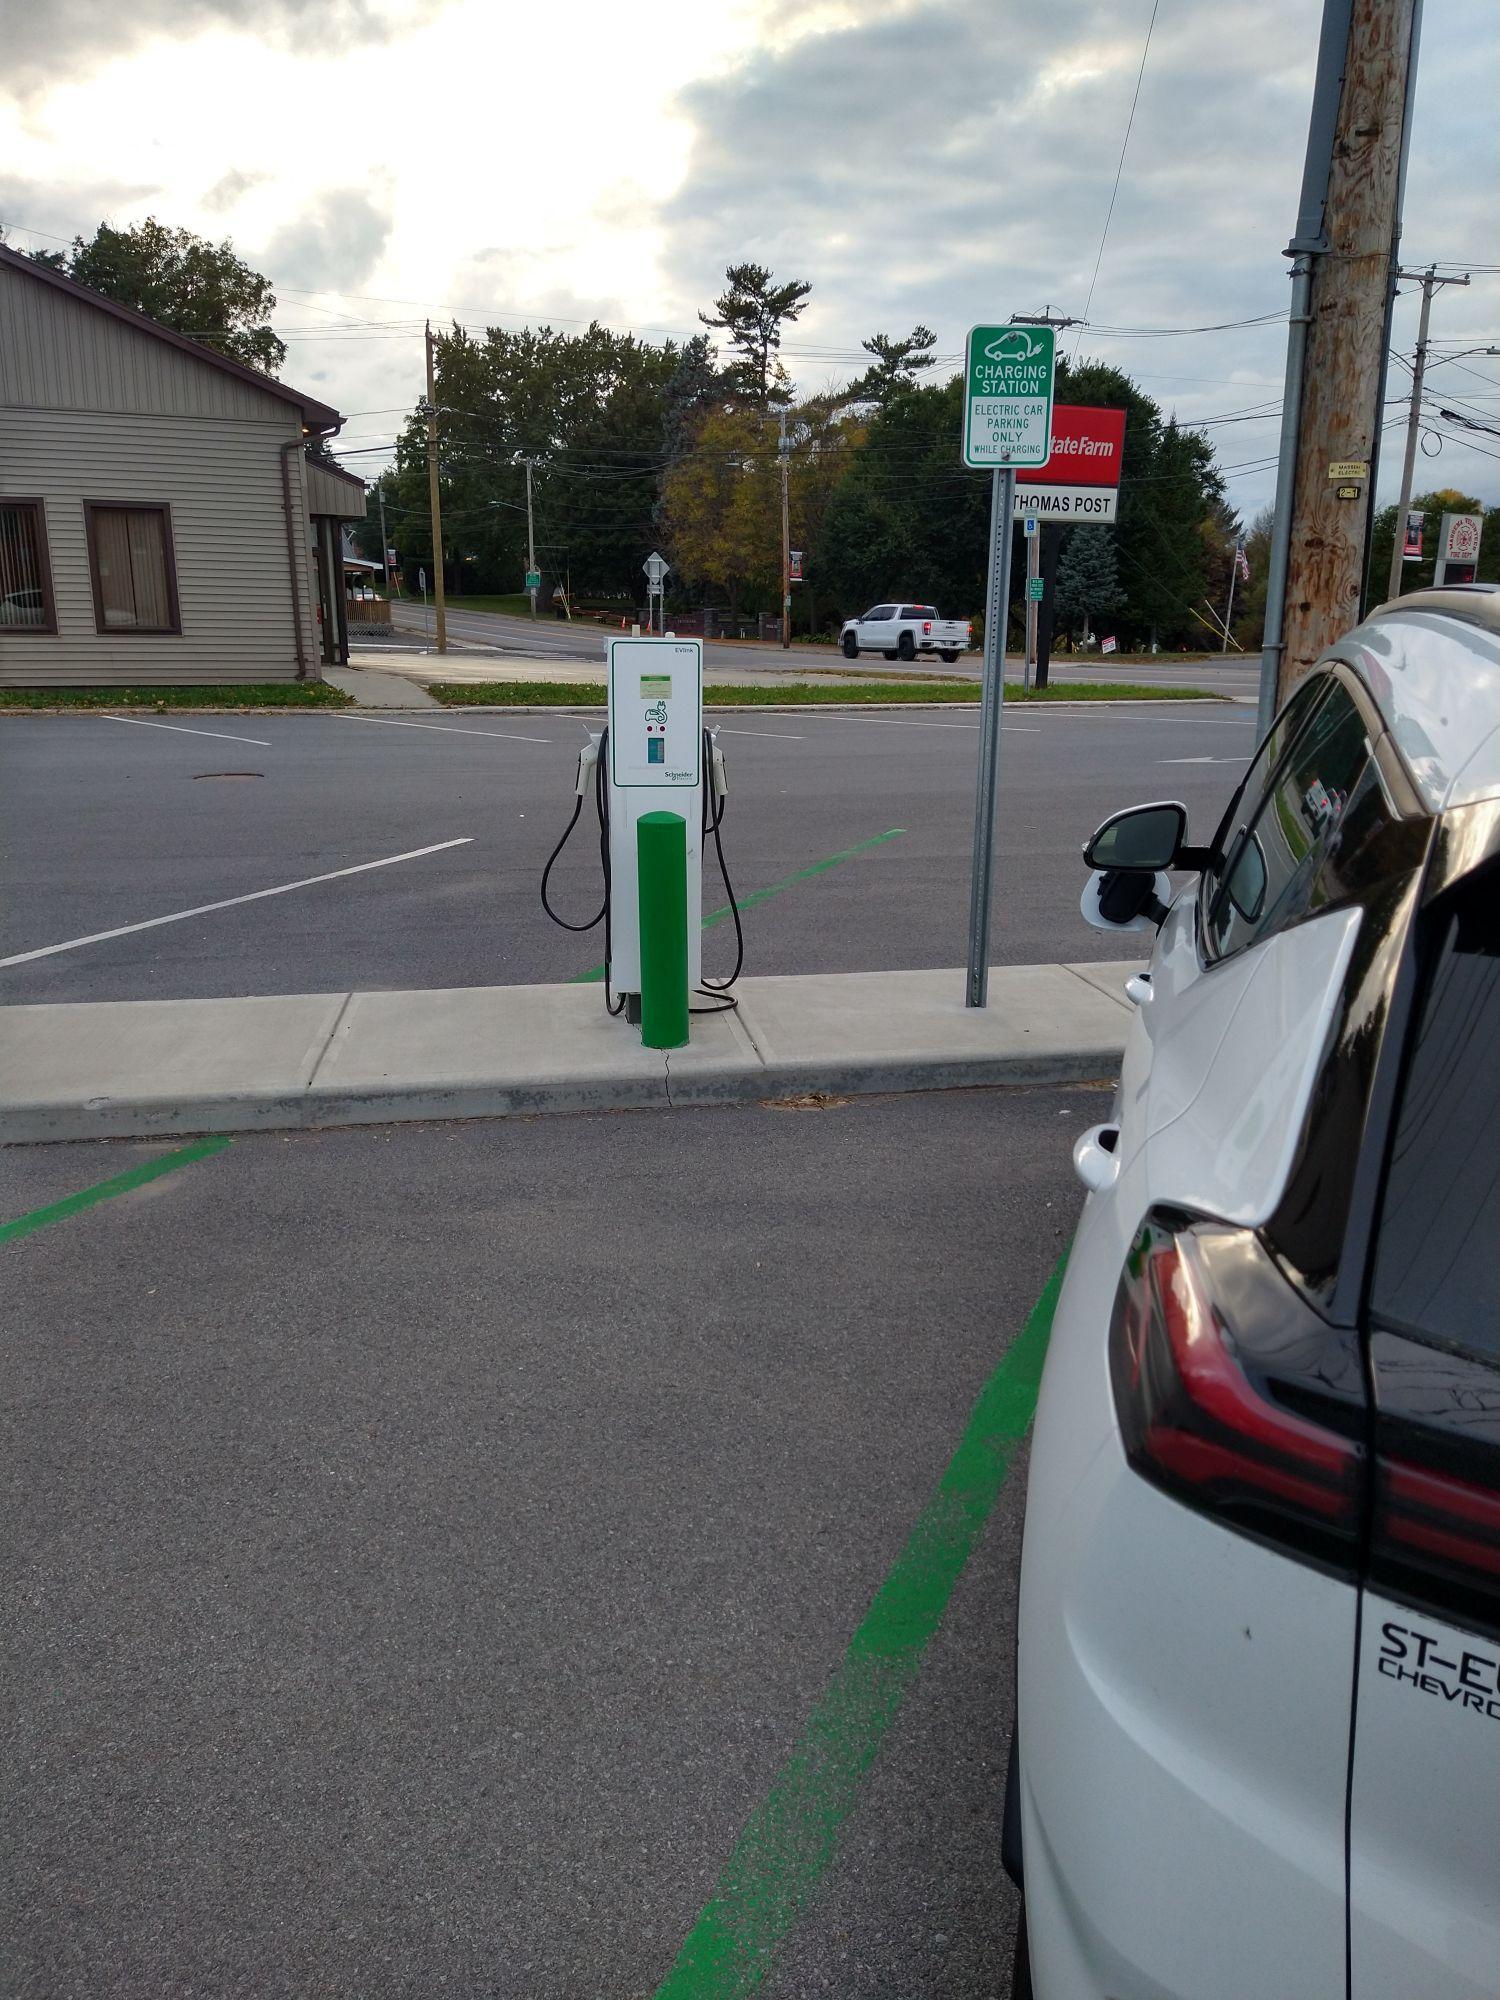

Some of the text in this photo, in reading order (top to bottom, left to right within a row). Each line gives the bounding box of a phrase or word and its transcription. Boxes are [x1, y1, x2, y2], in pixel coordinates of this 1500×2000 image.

[975, 365, 1047, 379] CHARGING
[982, 381, 1039, 394] STATION
[975, 405, 1043, 416] ELECTRIC CAR
[987, 418, 1029, 429] PARKING
[992, 432, 1023, 442] ONLY
[974, 445, 1041, 454] WHILE CHARGING
[1050, 436, 1114, 457] tateFarm
[1014, 494, 1111, 513] THOMAS POST
[664, 771, 693, 781] Schneider
[1380, 1622, 1500, 1695] ST-E
